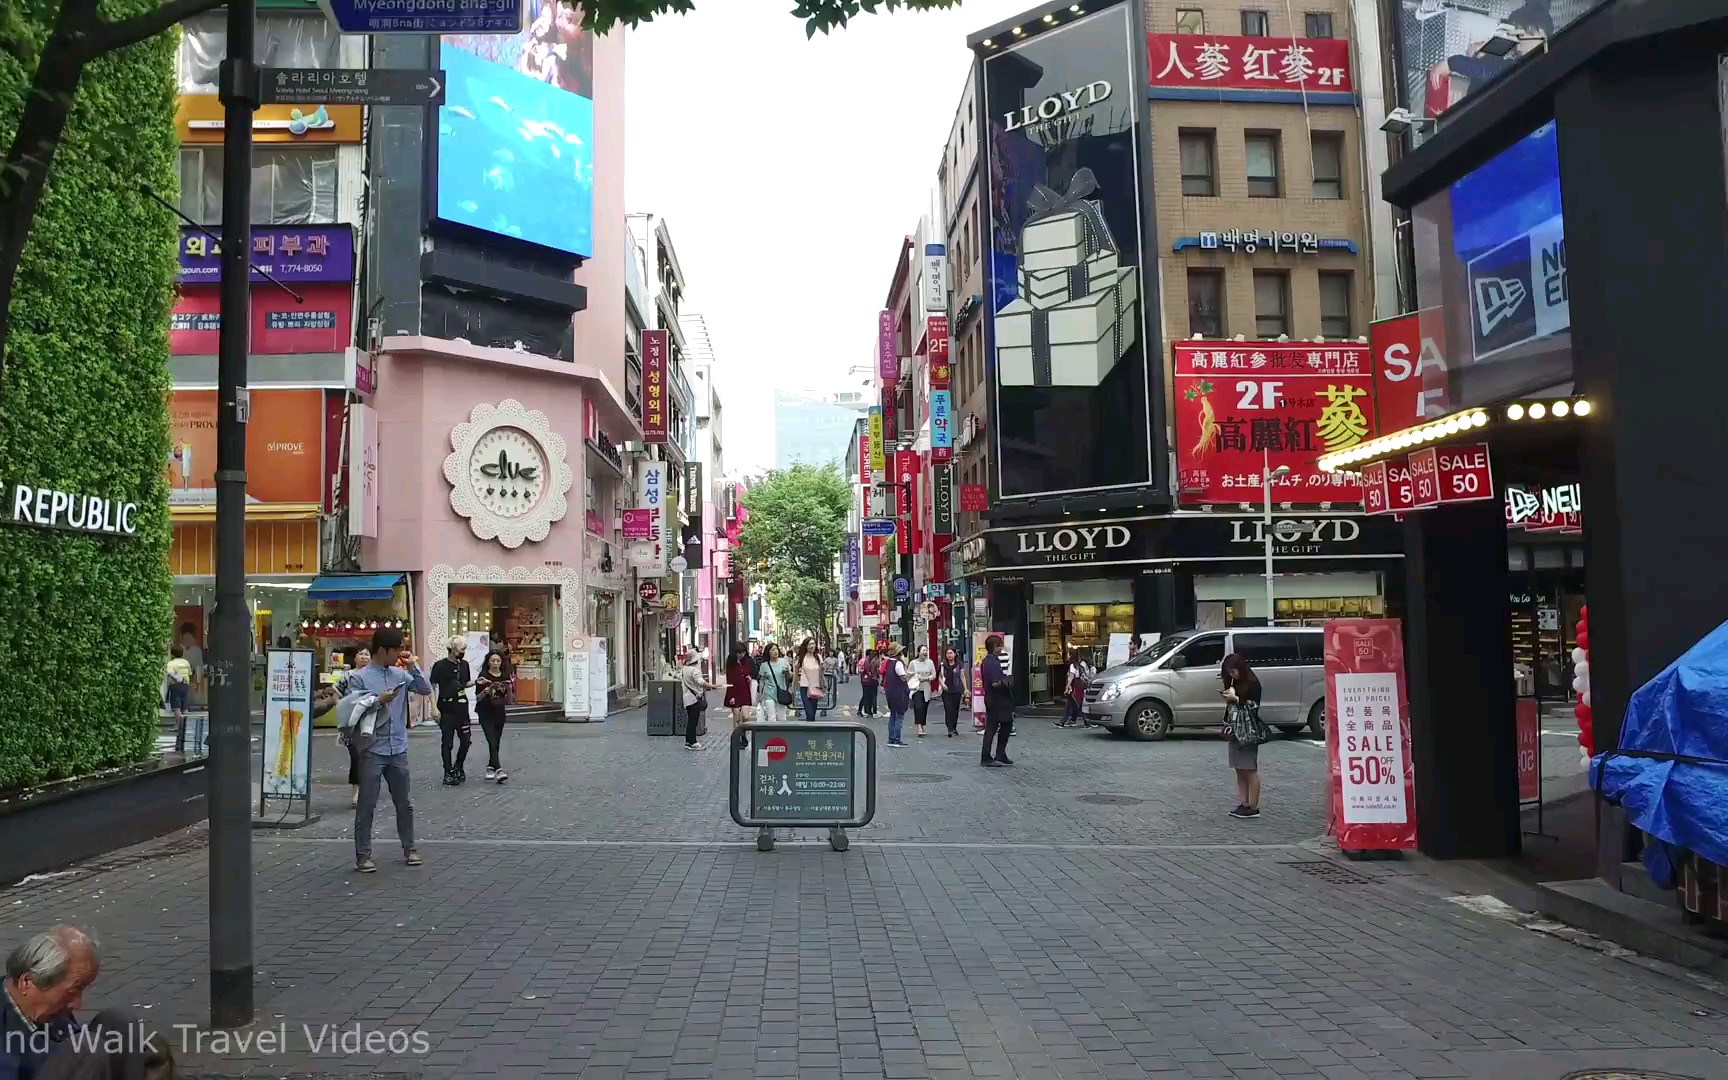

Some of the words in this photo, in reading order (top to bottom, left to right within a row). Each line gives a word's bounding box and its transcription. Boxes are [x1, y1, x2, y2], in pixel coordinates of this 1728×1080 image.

[276, 71, 367, 86] 솔라리아호텔
[1317, 67, 1346, 86] 2F
[1003, 80, 1112, 132] LLOYD
[1028, 122, 1052, 135] THE
[1053, 112, 1081, 127] GIFT
[254, 235, 330, 256] 피부과
[1222, 228, 1318, 254] 백명기의원
[930, 339, 947, 353] 2F
[649, 371, 662, 427] 성형외과
[1235, 381, 1284, 410] 2F
[934, 394, 949, 444] 푸른약국
[903, 456, 913, 474] The
[1411, 459, 1434, 477] SALE
[1439, 453, 1487, 471] SALE
[1363, 471, 1383, 487] SALE
[1388, 467, 1411, 482] SA
[1452, 473, 1479, 493] 50
[1419, 478, 1431, 498] 50
[940, 477, 950, 524] LLOYD
[1369, 490, 1381, 507] 50
[14, 484, 137, 534] REPUBLIC
[1017, 526, 1131, 553] LLOYD
[1229, 519, 1360, 543] LLOYD
[1069, 552, 1097, 561] GIFT
[1291, 545, 1321, 553] GIFT
[1343, 686, 1391, 694] EVERYTHING
[1347, 736, 1393, 753] SALE
[796, 752, 845, 761] 보행전용거리
[1380, 756, 1394, 765] OFF
[760, 786, 776, 796] 서울
